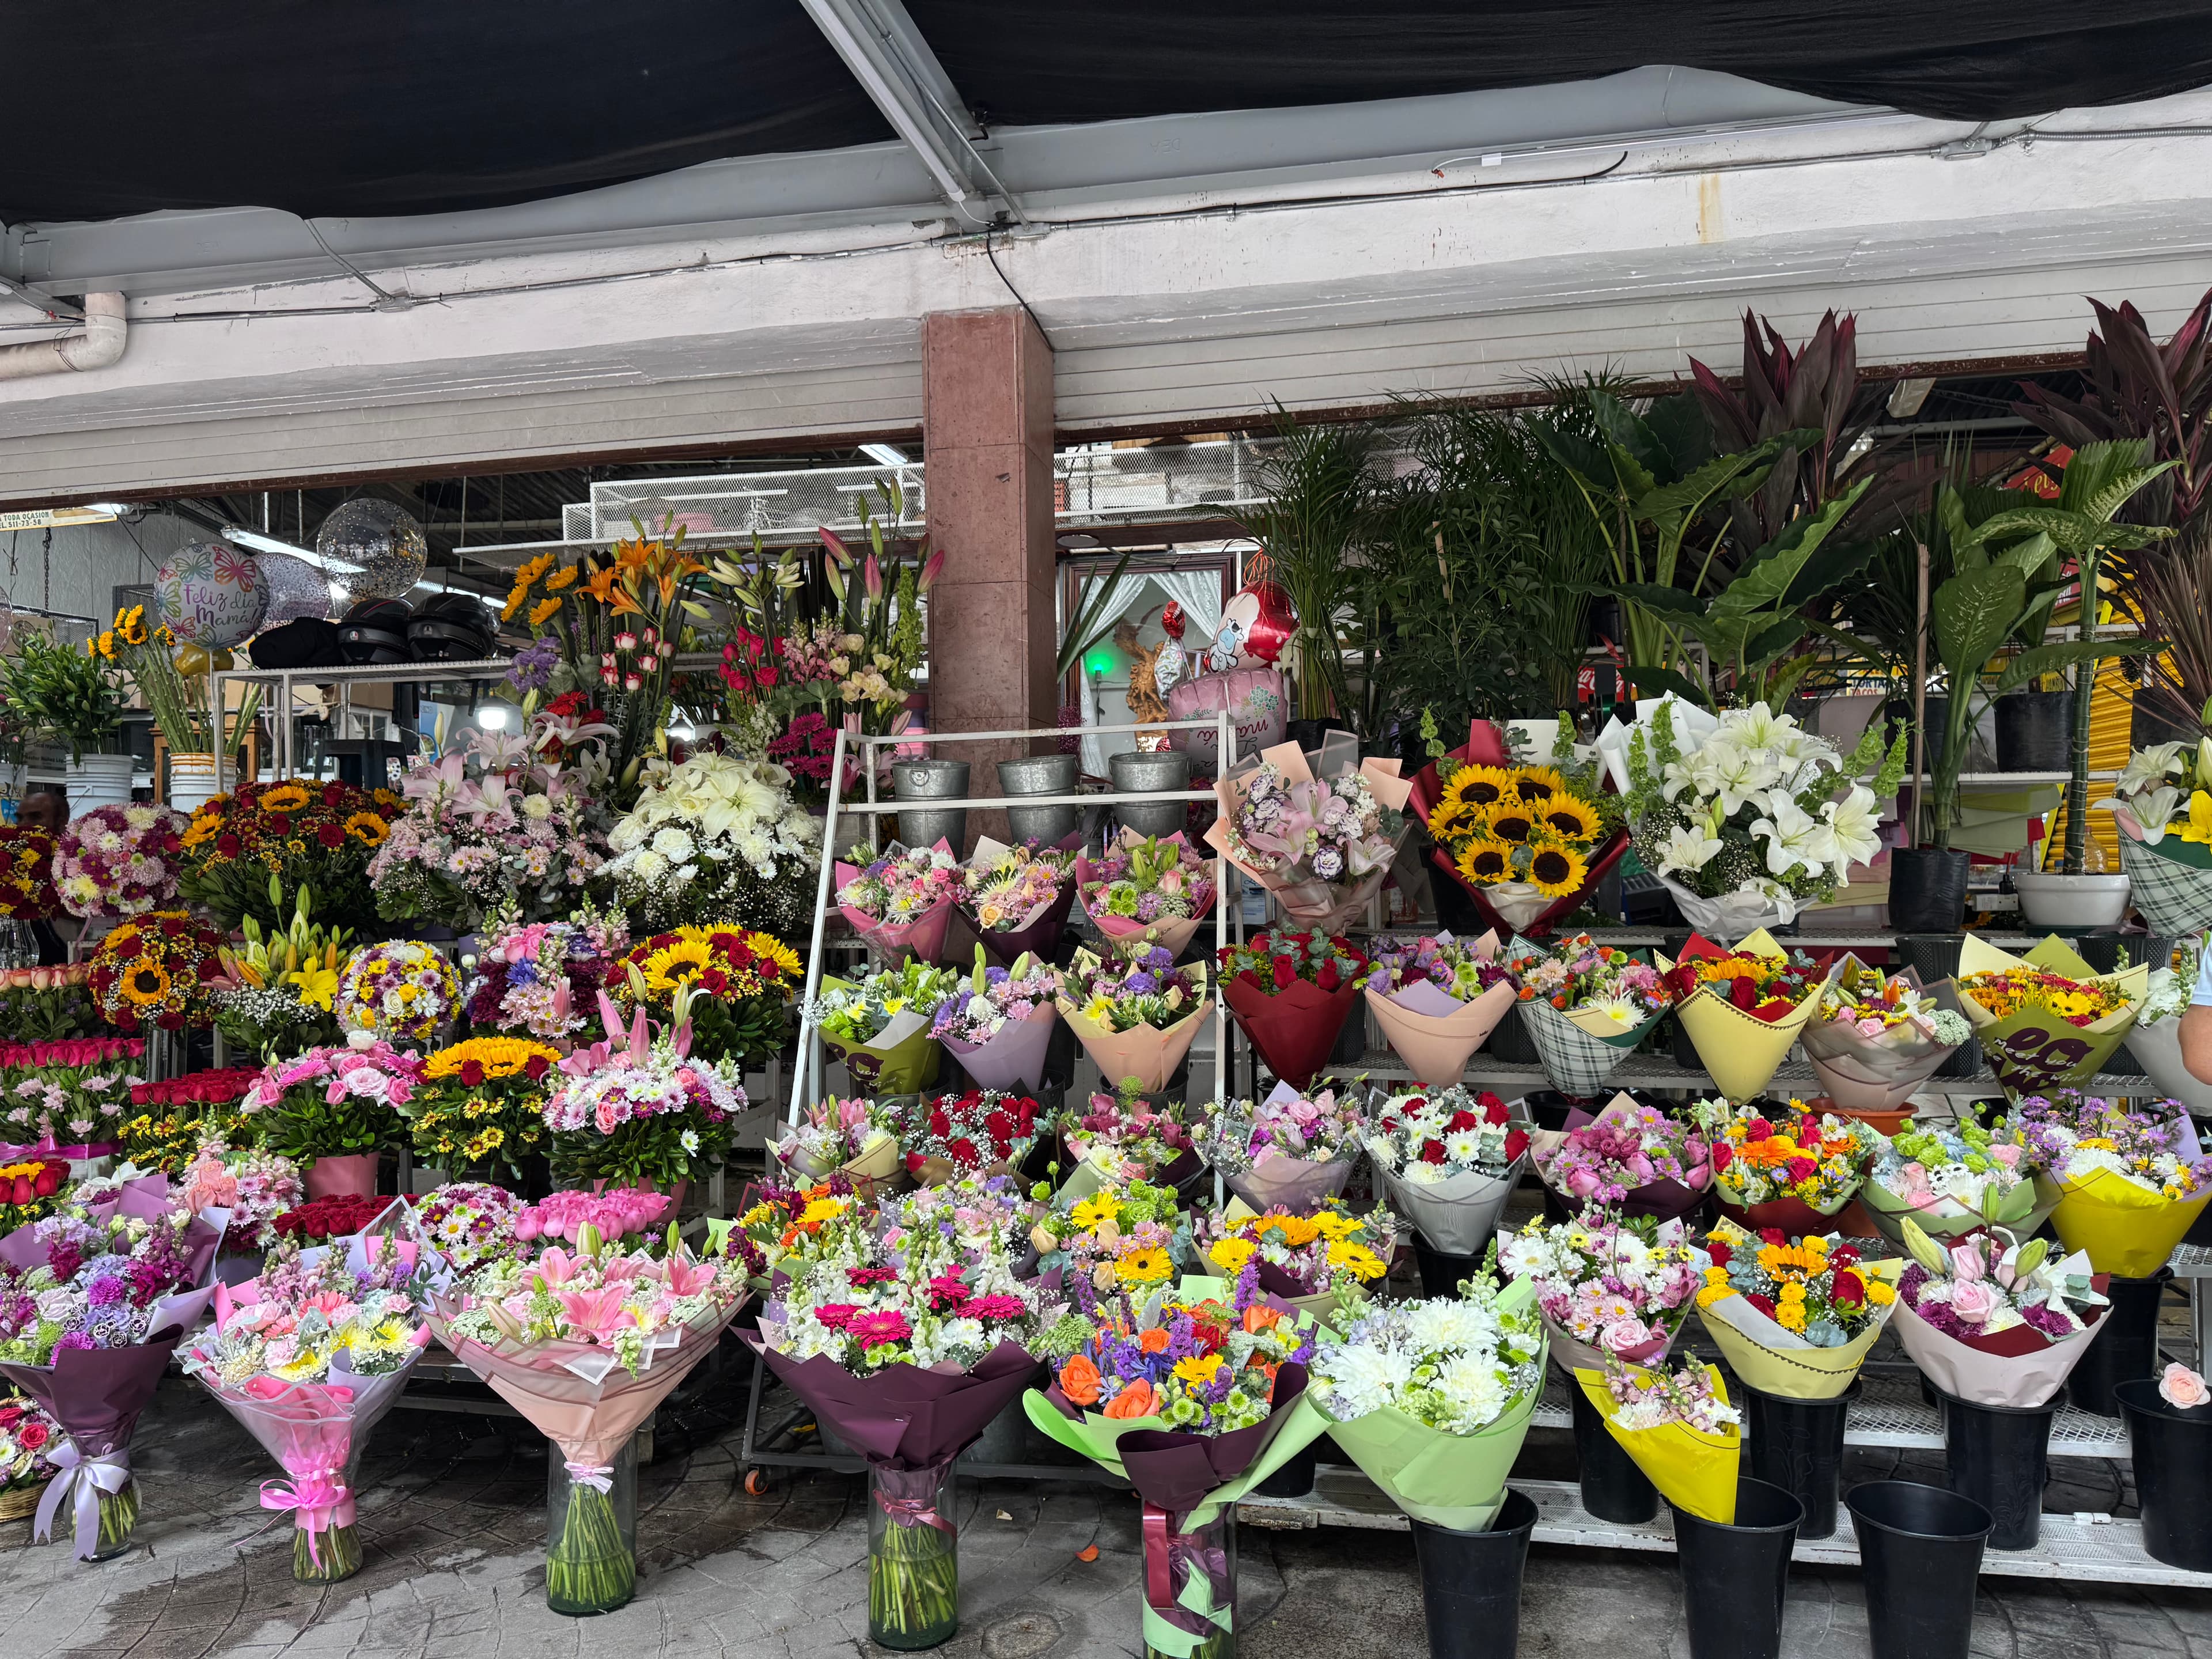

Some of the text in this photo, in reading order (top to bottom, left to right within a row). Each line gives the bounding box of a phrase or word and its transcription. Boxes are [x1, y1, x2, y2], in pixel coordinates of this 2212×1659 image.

[8, 519, 41, 528] 511-73-58
[183, 584, 256, 612] Feliz día
[196, 604, 258, 628] Mamá!
[1993, 1038, 2077, 1067] Meet you
[2011, 1065, 2041, 1078] the
